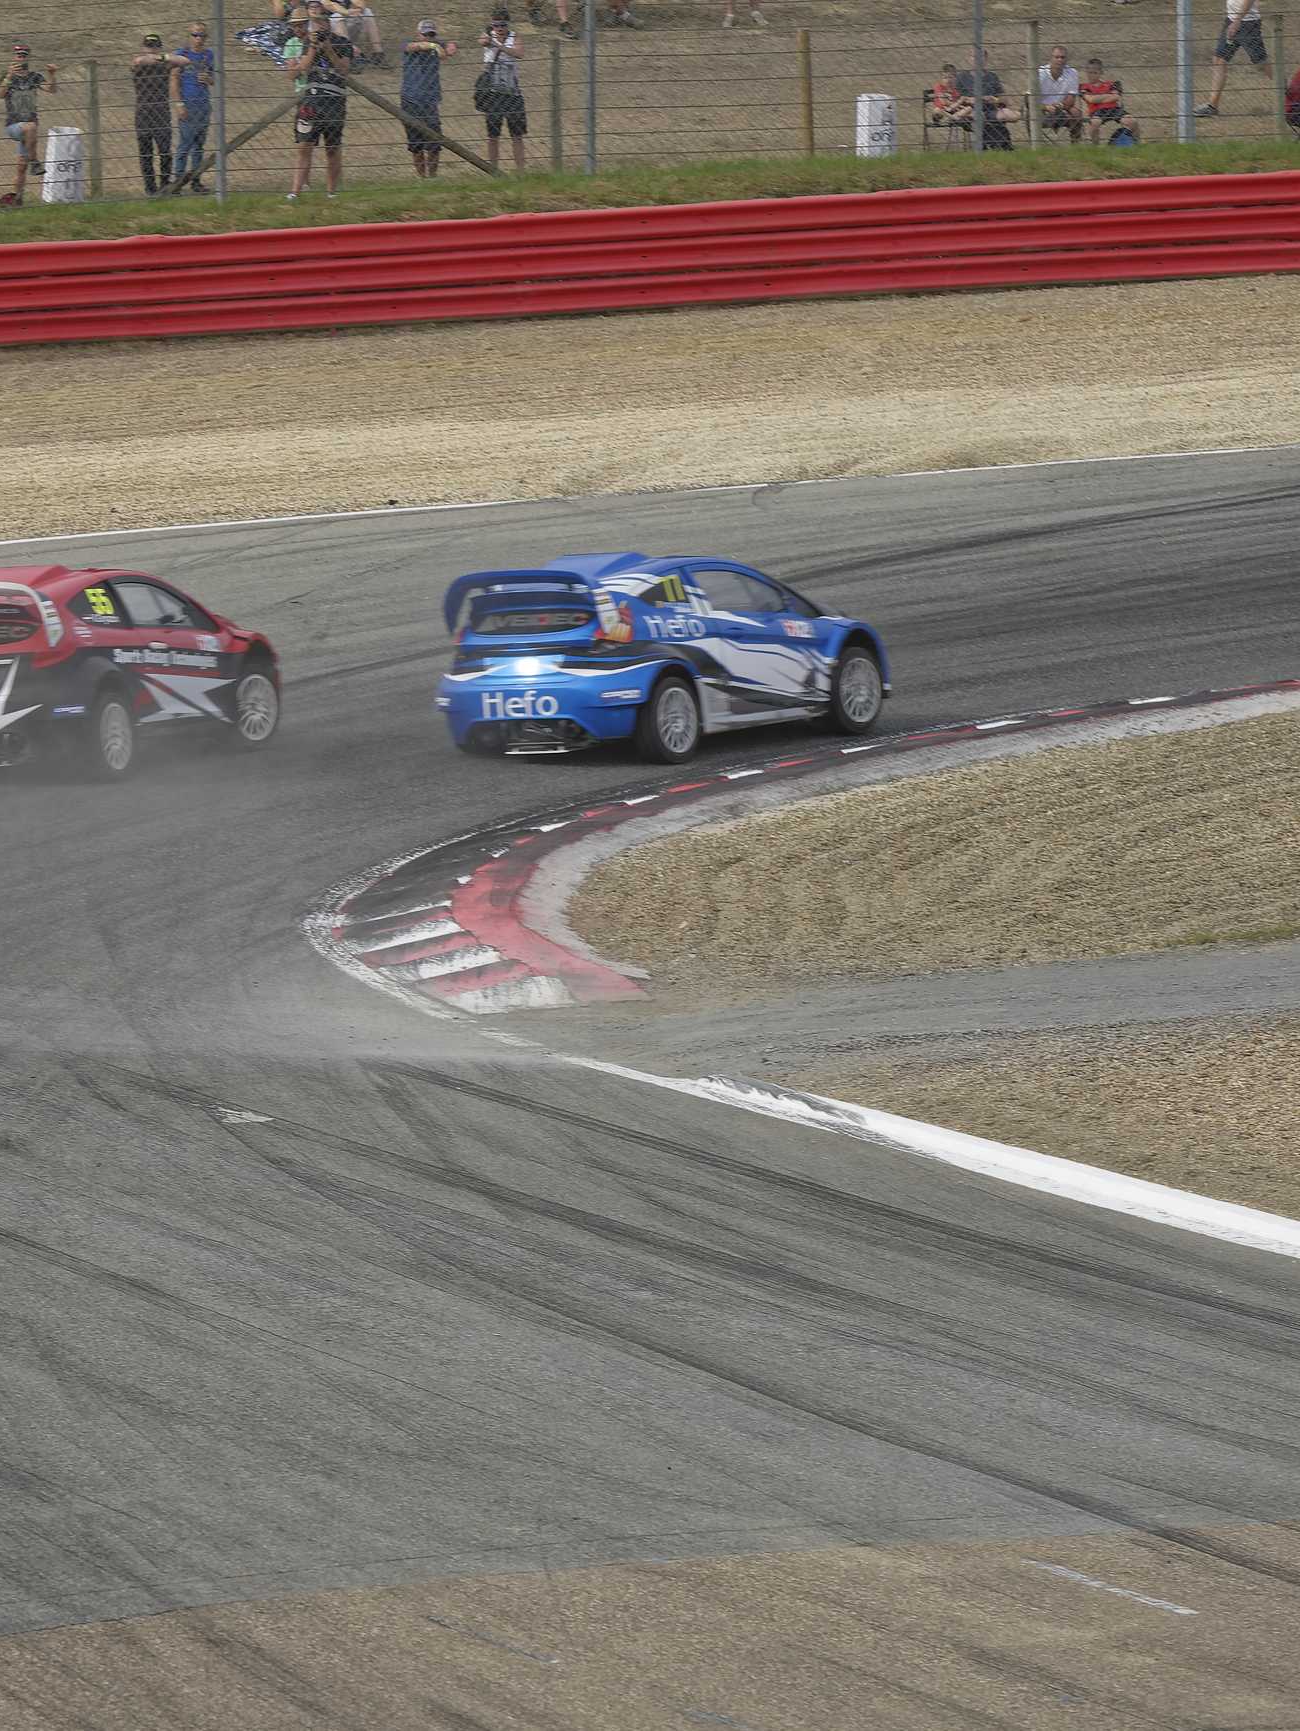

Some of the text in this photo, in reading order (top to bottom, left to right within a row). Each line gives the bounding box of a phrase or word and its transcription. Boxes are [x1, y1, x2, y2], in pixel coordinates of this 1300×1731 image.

[83, 588, 115, 615] 55
[642, 614, 707, 639] Hefo
[481, 690, 559, 718] Hefo
